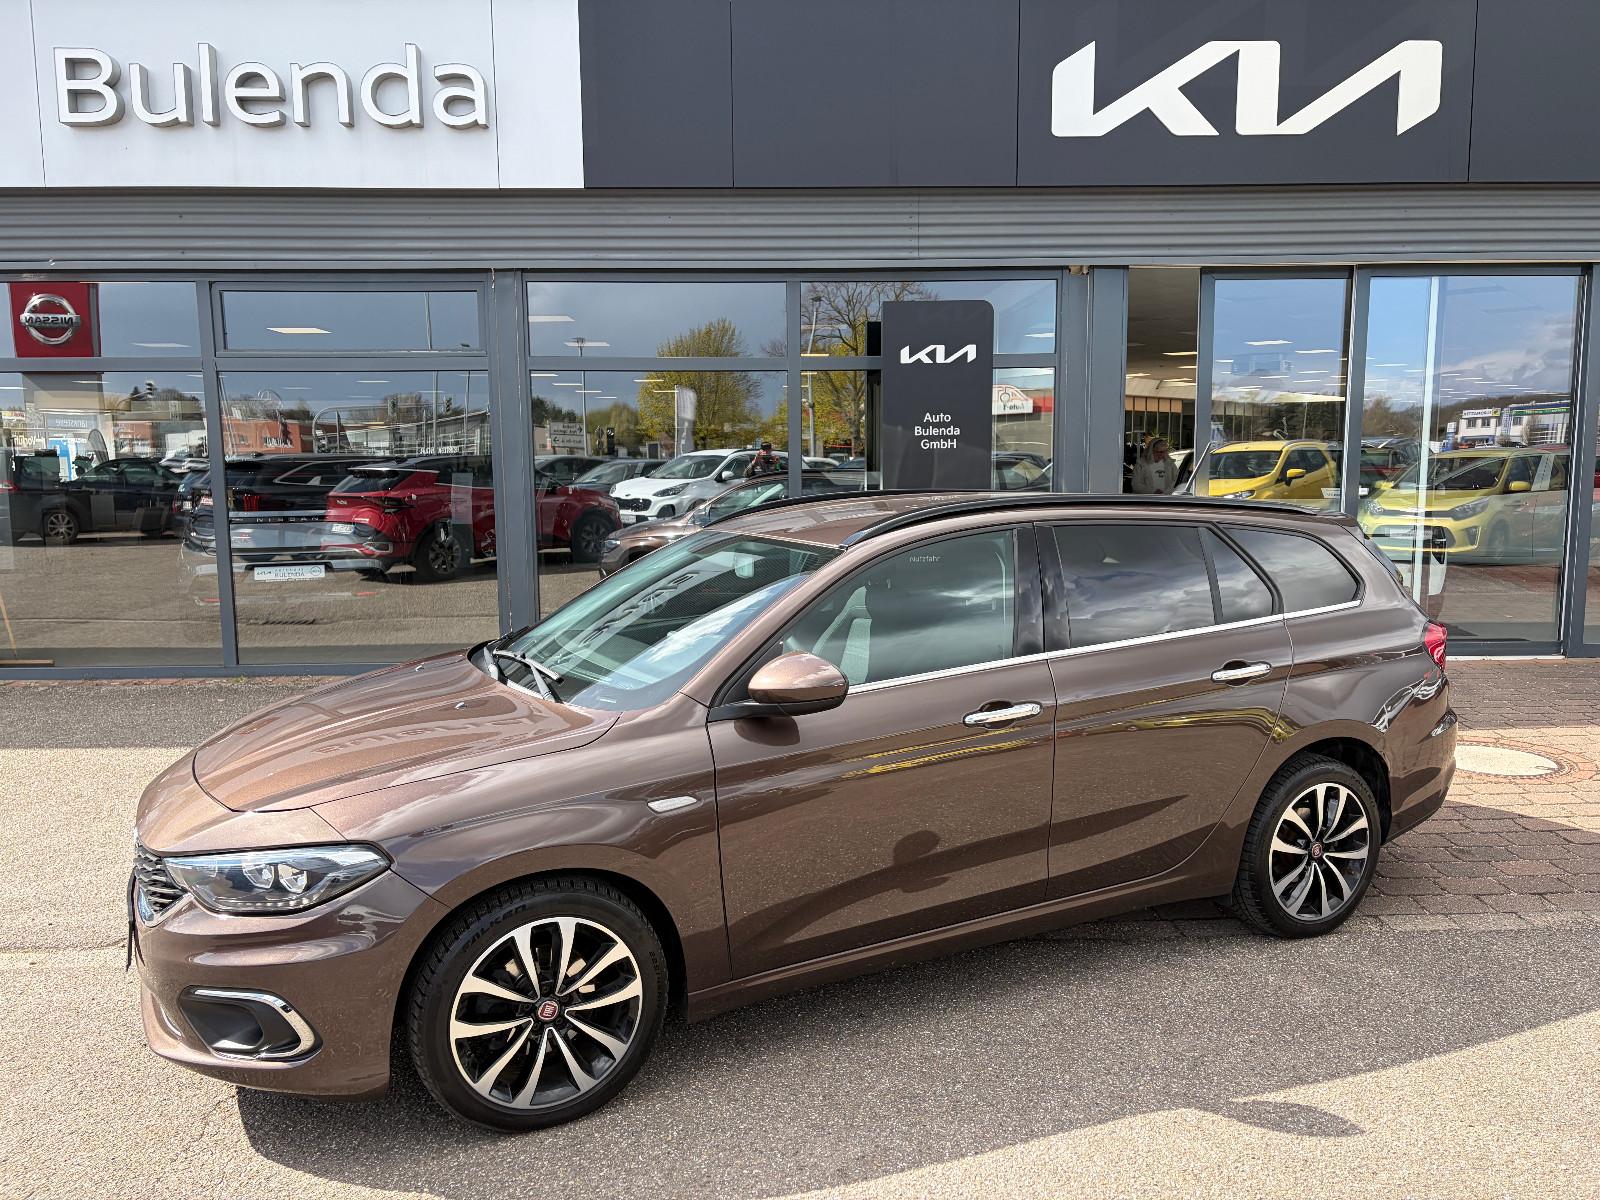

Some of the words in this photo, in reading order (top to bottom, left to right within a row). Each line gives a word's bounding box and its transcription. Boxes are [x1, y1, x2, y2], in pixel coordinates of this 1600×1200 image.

[53, 43, 490, 129] Bulenda
[1051, 39, 1443, 137] KIA
[900, 344, 977, 364] KIA
[923, 412, 952, 423] Auto
[914, 426, 961, 437] Bulenda
[920, 439, 958, 450] GmbH
[542, 1004, 555, 1017] FIAT
